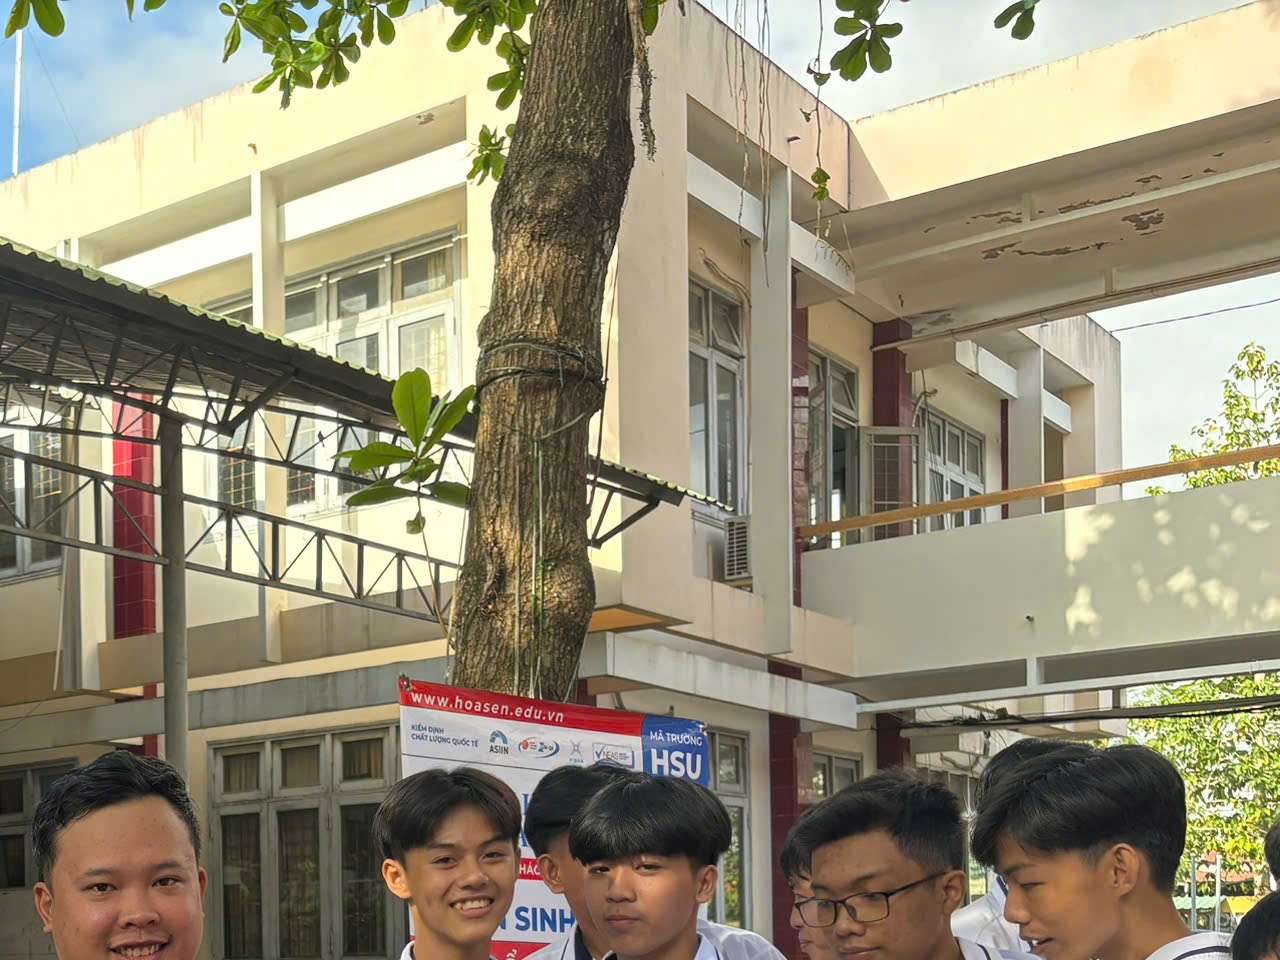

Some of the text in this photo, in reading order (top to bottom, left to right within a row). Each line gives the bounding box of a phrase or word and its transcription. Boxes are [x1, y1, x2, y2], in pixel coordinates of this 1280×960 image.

[410, 691, 565, 723] www.hoasen.edu.vn
[649, 731, 703, 747] MÃ TRƯỜNG
[489, 745, 509, 755] ASIIN
[651, 749, 702, 780] HSU
[519, 863, 541, 876] HÁC
